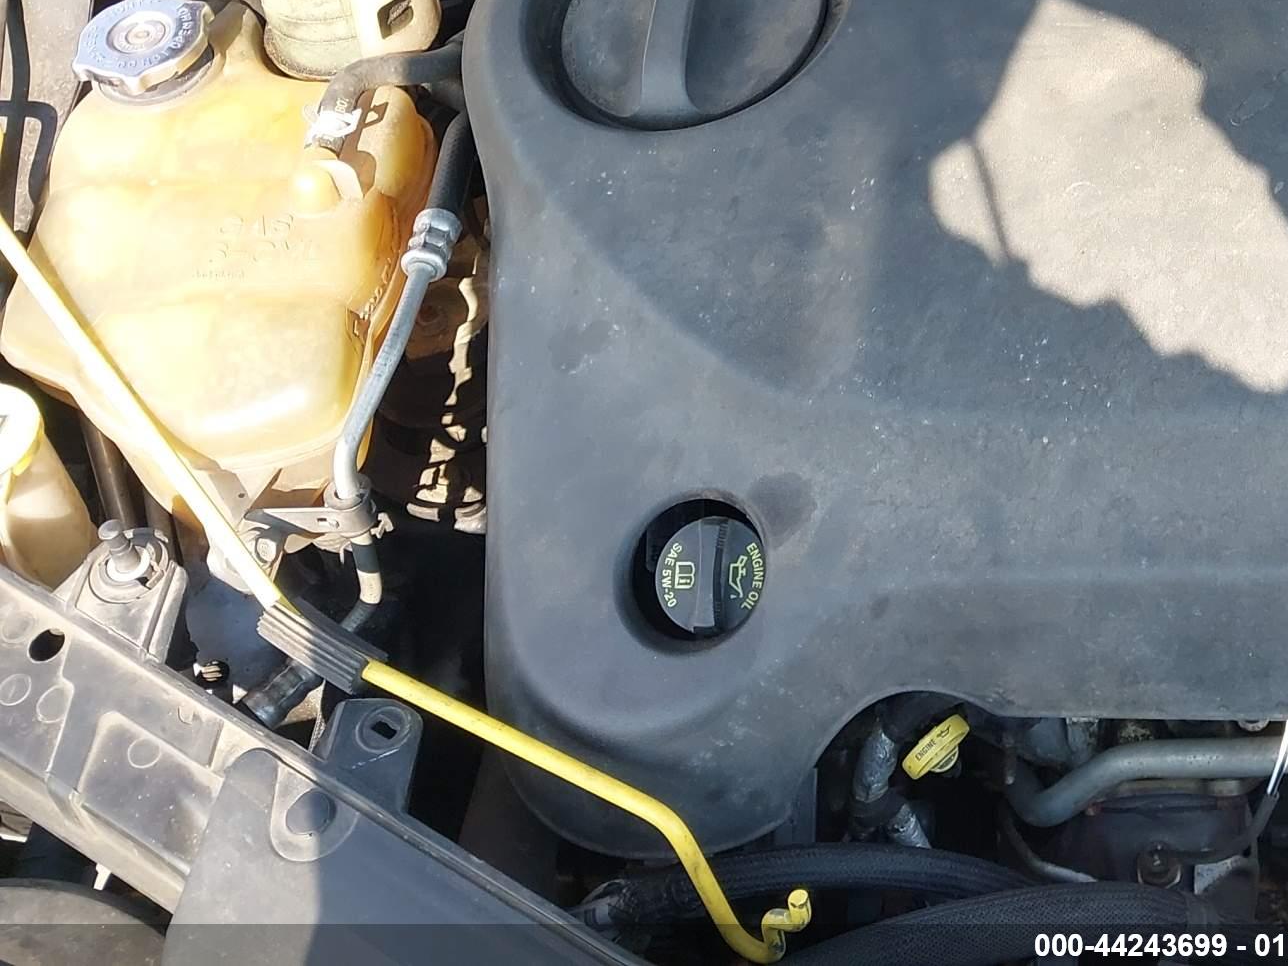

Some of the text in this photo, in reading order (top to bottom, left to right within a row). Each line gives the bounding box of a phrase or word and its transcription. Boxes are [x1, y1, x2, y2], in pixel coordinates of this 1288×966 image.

[661, 542, 683, 609] SAE 5W-20
[740, 541, 766, 611] ENGINE OIL
[914, 738, 937, 762] ENGINE
